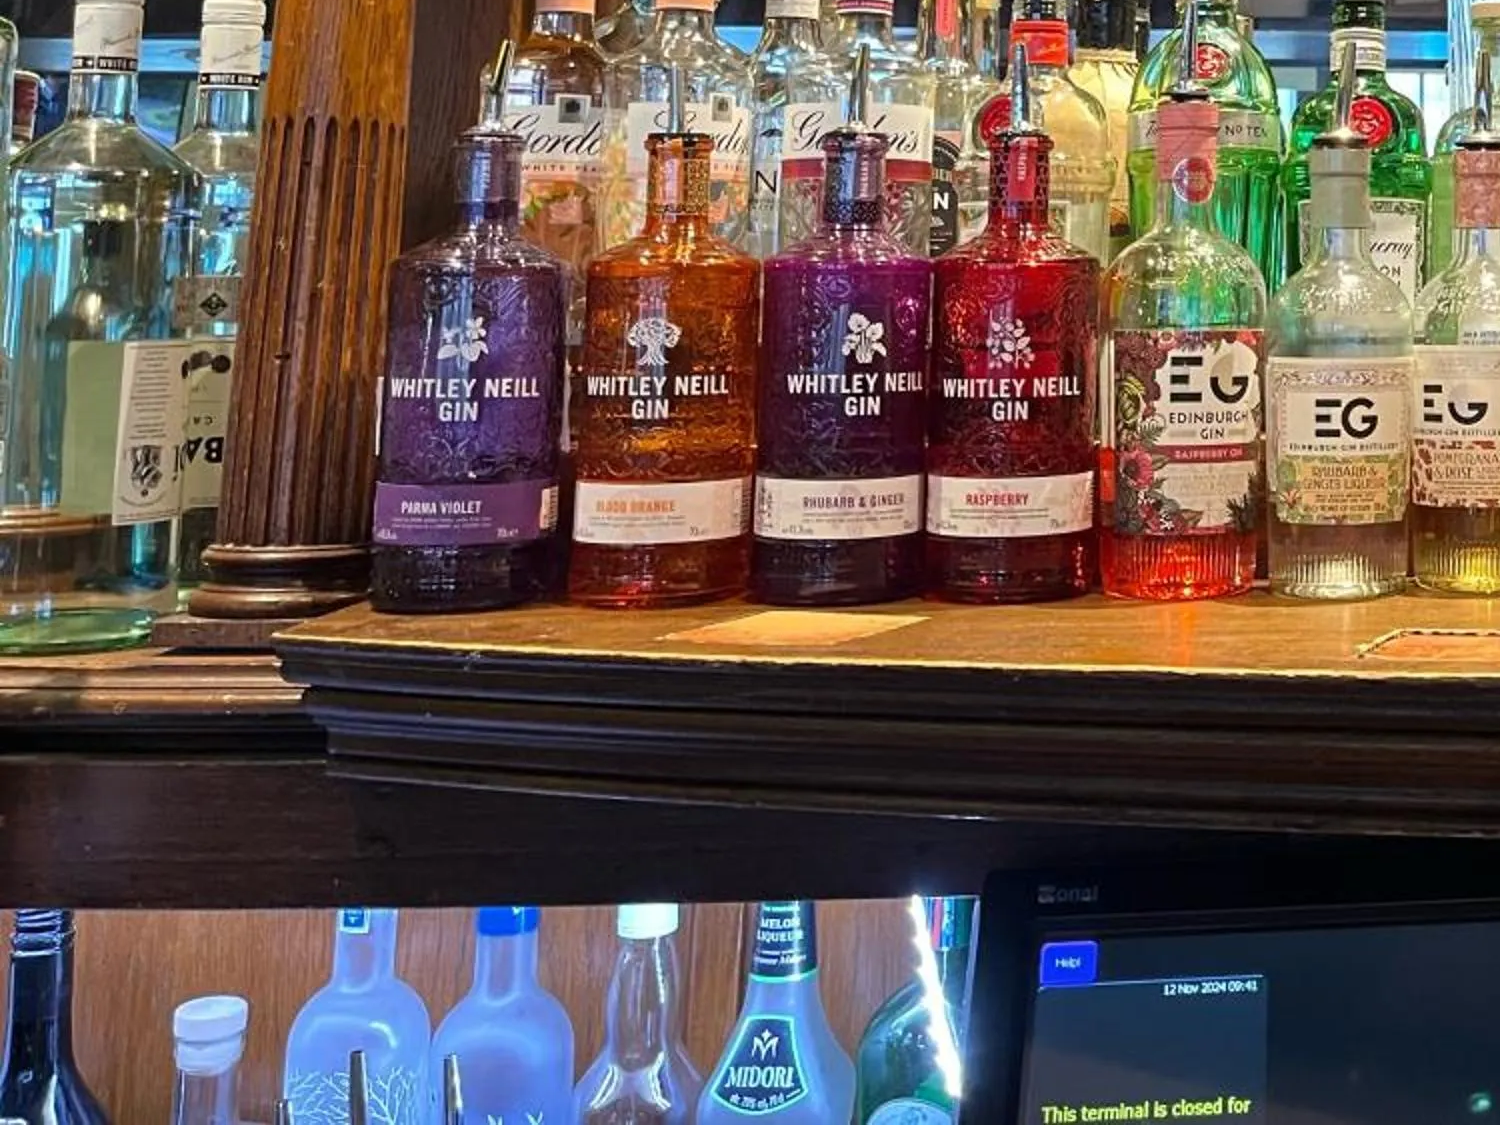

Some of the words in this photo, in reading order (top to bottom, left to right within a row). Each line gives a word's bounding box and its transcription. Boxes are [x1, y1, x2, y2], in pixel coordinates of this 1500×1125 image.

[391, 377, 476, 398] WHITLEY
[484, 376, 540, 398] NEILL
[587, 375, 667, 396] WHITLEY
[675, 374, 728, 395] NEILL
[787, 373, 878, 394] WHITLEY
[885, 372, 922, 392] NEILL
[943, 377, 1025, 398] WHITLEY
[1033, 376, 1081, 397] NEILL
[439, 401, 478, 422] GIN
[631, 399, 669, 420] GIN
[845, 396, 881, 416] GIN
[991, 400, 1029, 421] GIN
[1169, 410, 1249, 425] EDINBURGH
[1315, 397, 1378, 438] EG
[1199, 426, 1225, 440] GIN
[401, 501, 437, 515] PARMA
[440, 500, 482, 515] VIOLET
[630, 499, 676, 513] ORANGE
[803, 495, 855, 509] RHUBARB
[858, 496, 868, 509] &
[869, 492, 905, 508] GINGER
[965, 493, 1030, 507] RASPBERRY
[1163, 984, 1177, 996] 12
[1178, 982, 1199, 994] Nov
[1201, 981, 1226, 994] 2024
[1228, 980, 1258, 993] 09:41
[725, 1066, 795, 1088] MIDORI
[1042, 1106, 1077, 1124] This
[1081, 1101, 1149, 1122] terminal
[1153, 1101, 1168, 1118] is
[1171, 1097, 1224, 1117] closed
[1227, 1095, 1251, 1114] for
